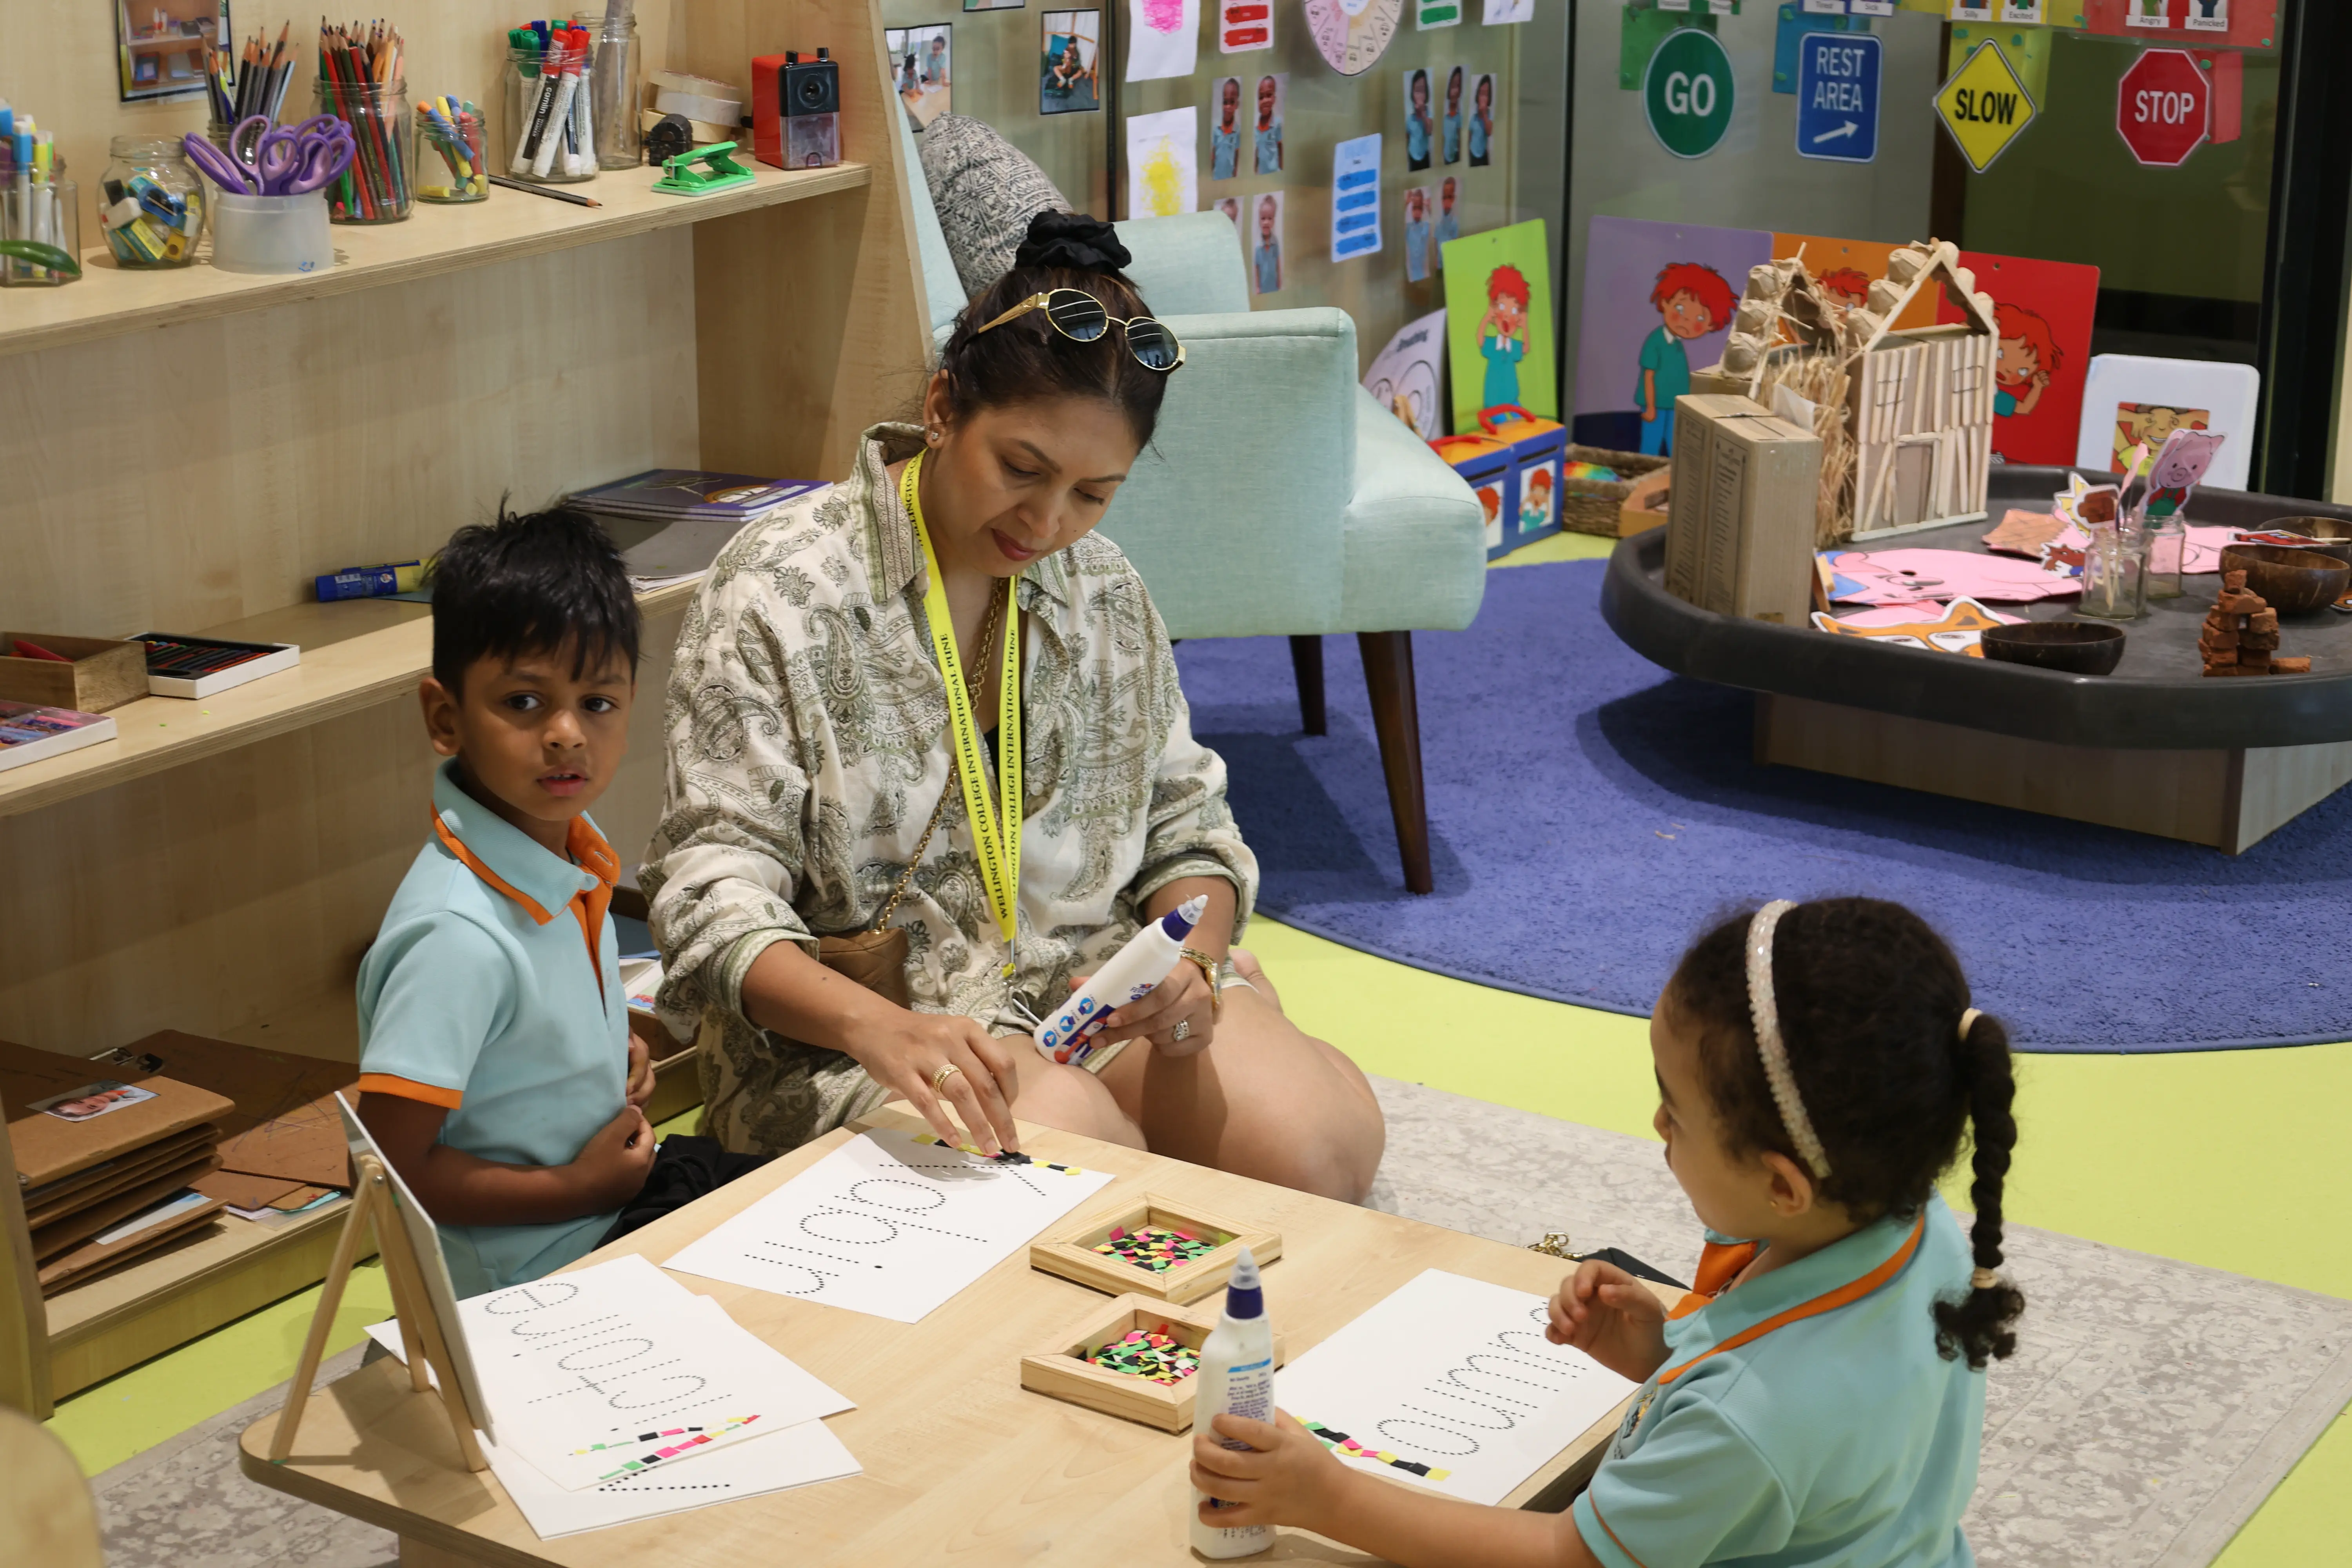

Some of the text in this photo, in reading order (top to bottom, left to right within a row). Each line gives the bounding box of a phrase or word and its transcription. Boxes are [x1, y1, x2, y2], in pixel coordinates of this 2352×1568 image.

[2139, 16, 2161, 25] Angry
[2192, 18, 2225, 27] Panicked
[1816, 46, 1865, 77] REST
[1664, 71, 1715, 117] GO
[1813, 81, 1863, 113] AREA
[1954, 87, 2018, 125] SLOW
[2134, 89, 2194, 125] STOP
[1006, 666, 1015, 769] INTERNATIONAL
[940, 633, 1008, 919] WELLINGTON COLLEGE INTERNATIONAL PUNE
[1007, 772, 1017, 828] COLLEGE
